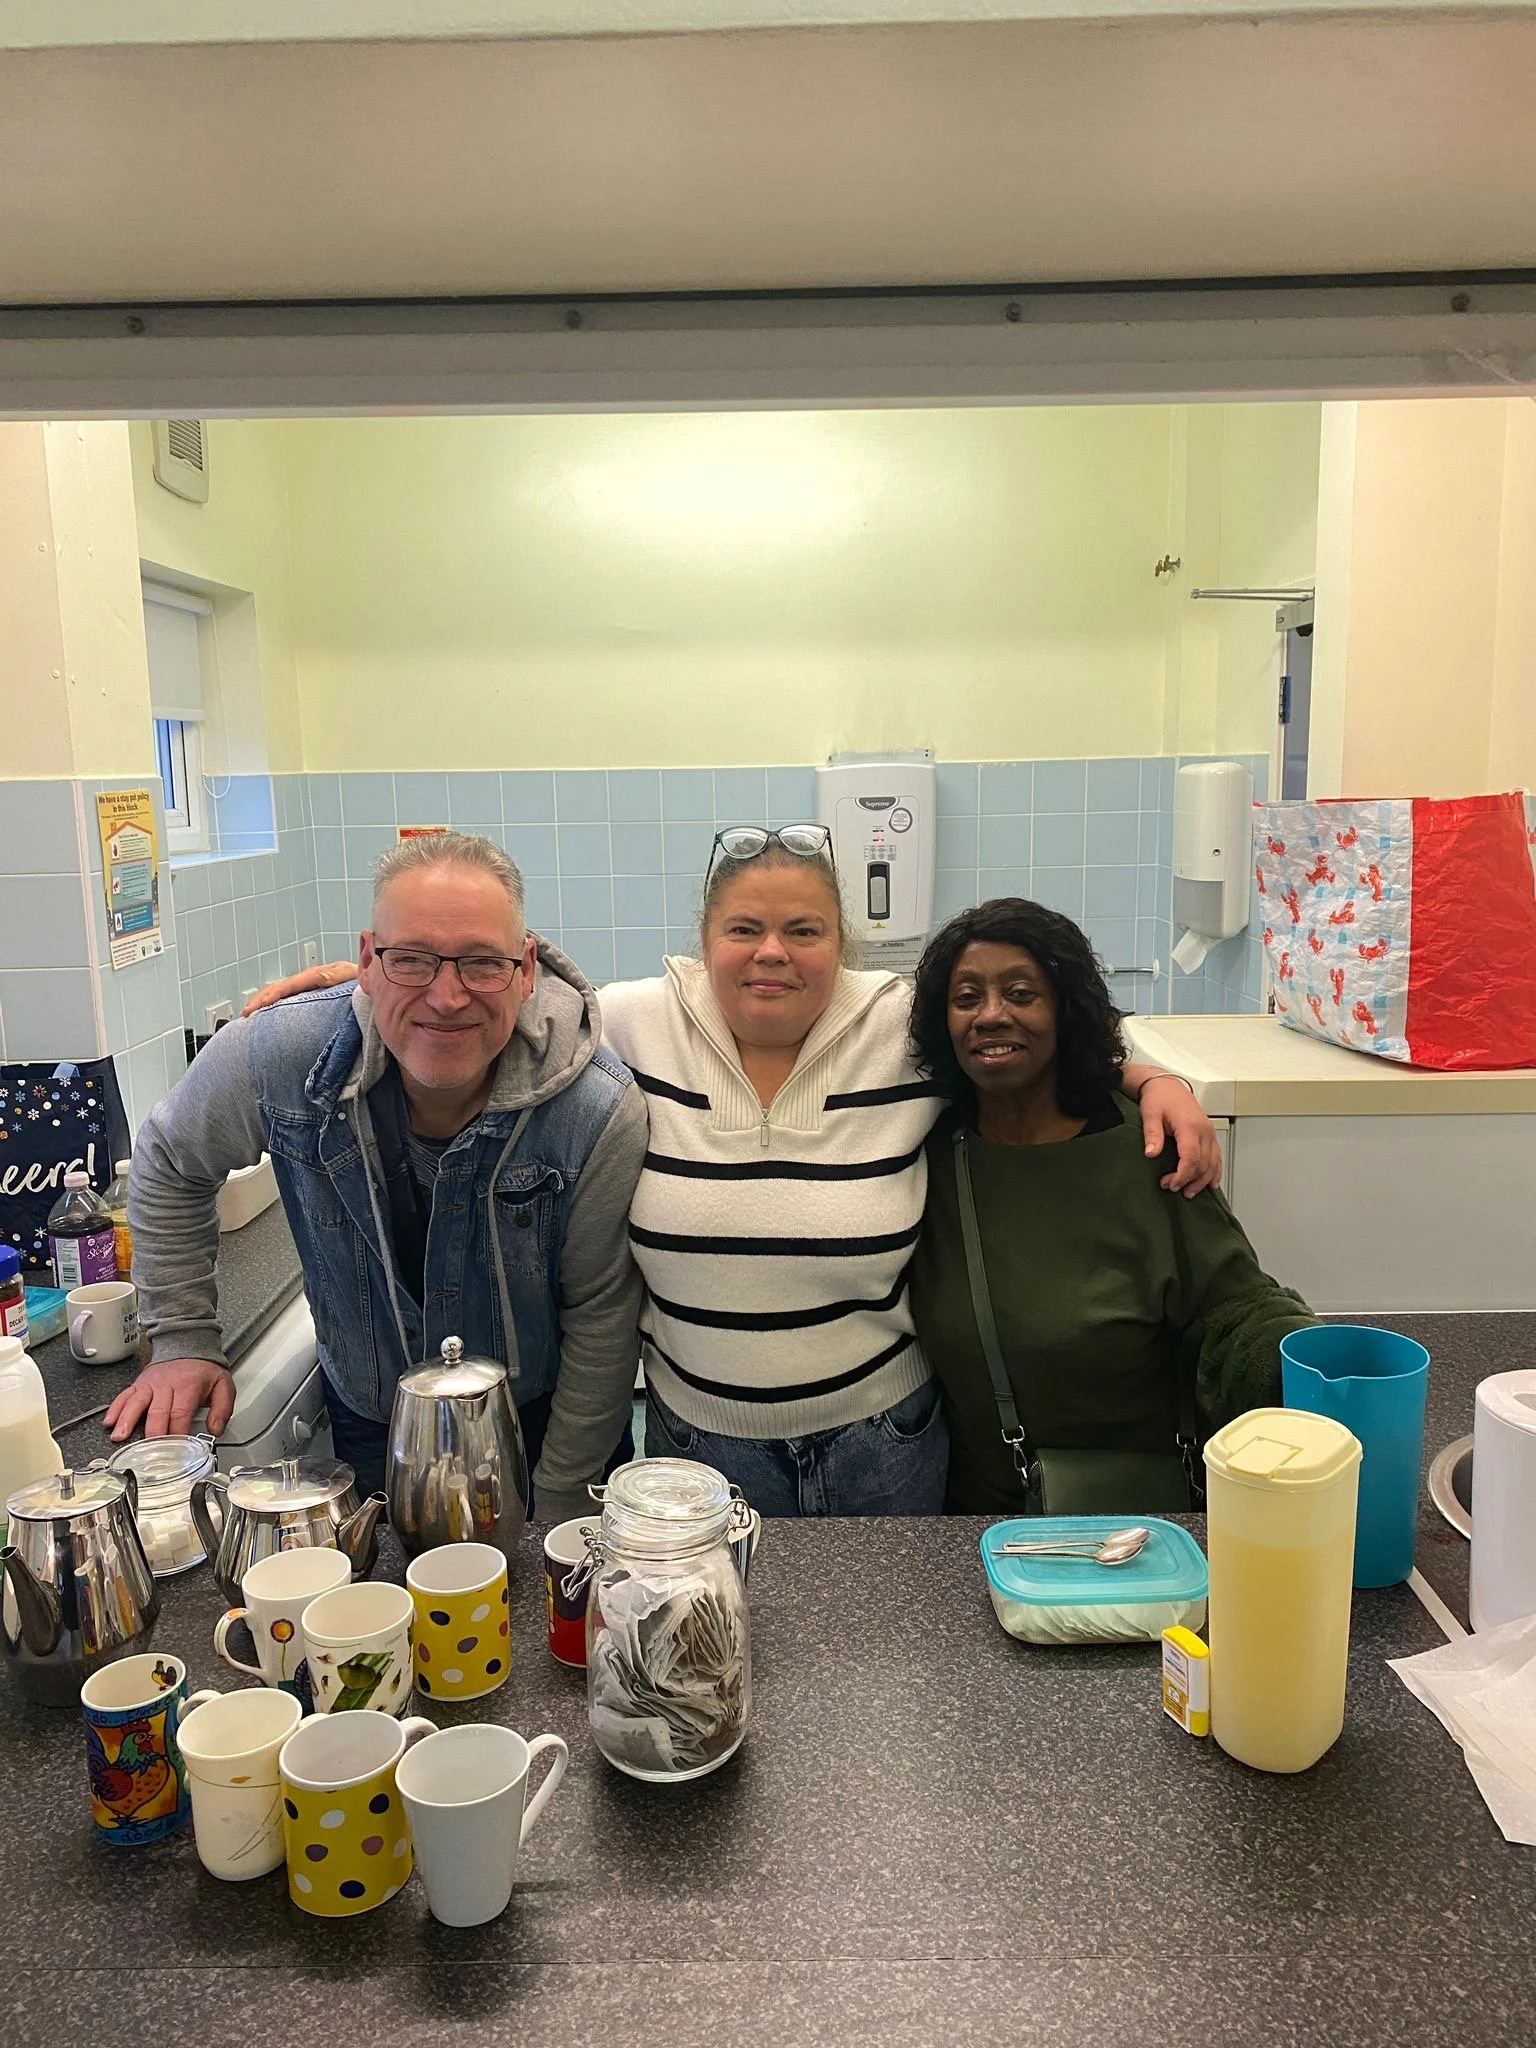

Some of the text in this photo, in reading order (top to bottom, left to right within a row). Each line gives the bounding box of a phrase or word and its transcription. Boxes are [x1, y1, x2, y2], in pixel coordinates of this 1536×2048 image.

[98, 795, 106, 804] We
[106, 795, 116, 803] have
[120, 794, 129, 803] stay
[137, 792, 150, 802] policy
[118, 804, 126, 812] this
[127, 803, 138, 811] block
